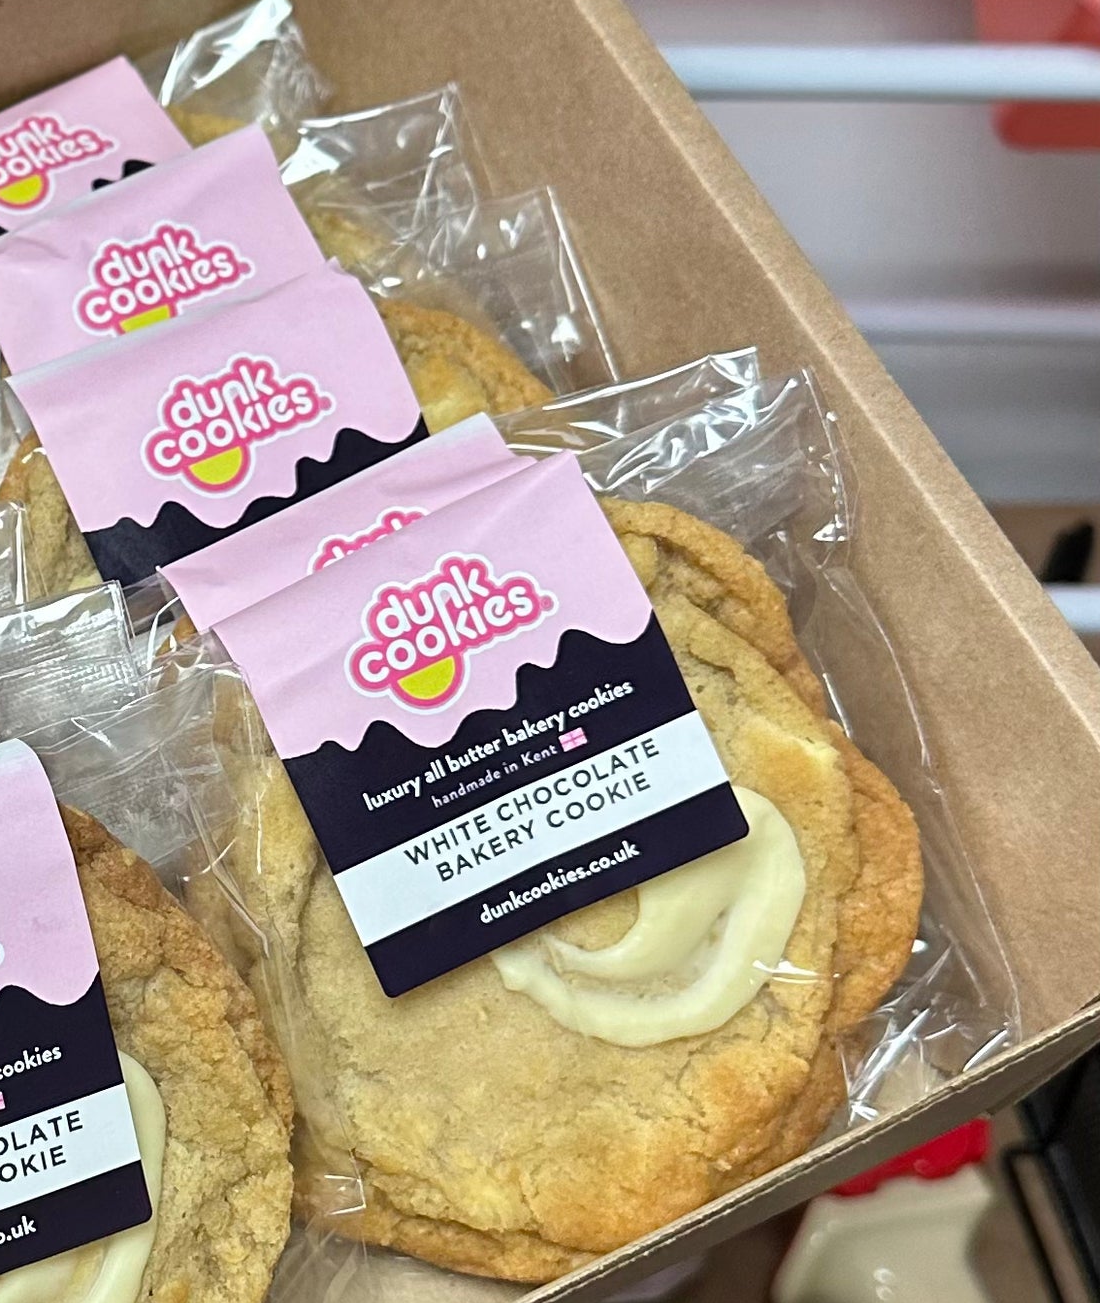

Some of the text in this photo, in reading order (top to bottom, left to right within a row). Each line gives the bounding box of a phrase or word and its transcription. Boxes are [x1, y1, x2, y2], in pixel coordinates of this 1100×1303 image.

[85, 253, 233, 323] cookies
[101, 233, 196, 286] dunk
[154, 387, 313, 467] cookies
[171, 365, 274, 428] dunk
[359, 587, 533, 682] cookies
[376, 565, 489, 637] dunk
[362, 681, 634, 812] luxury all butter bakery cookies
[431, 745, 558, 808] handmade in Kent
[403, 738, 660, 865] WHITE CHOCOLATE
[436, 771, 651, 882] BAKERY COOKIE
[480, 840, 641, 924] dunkcookies.co.uk
